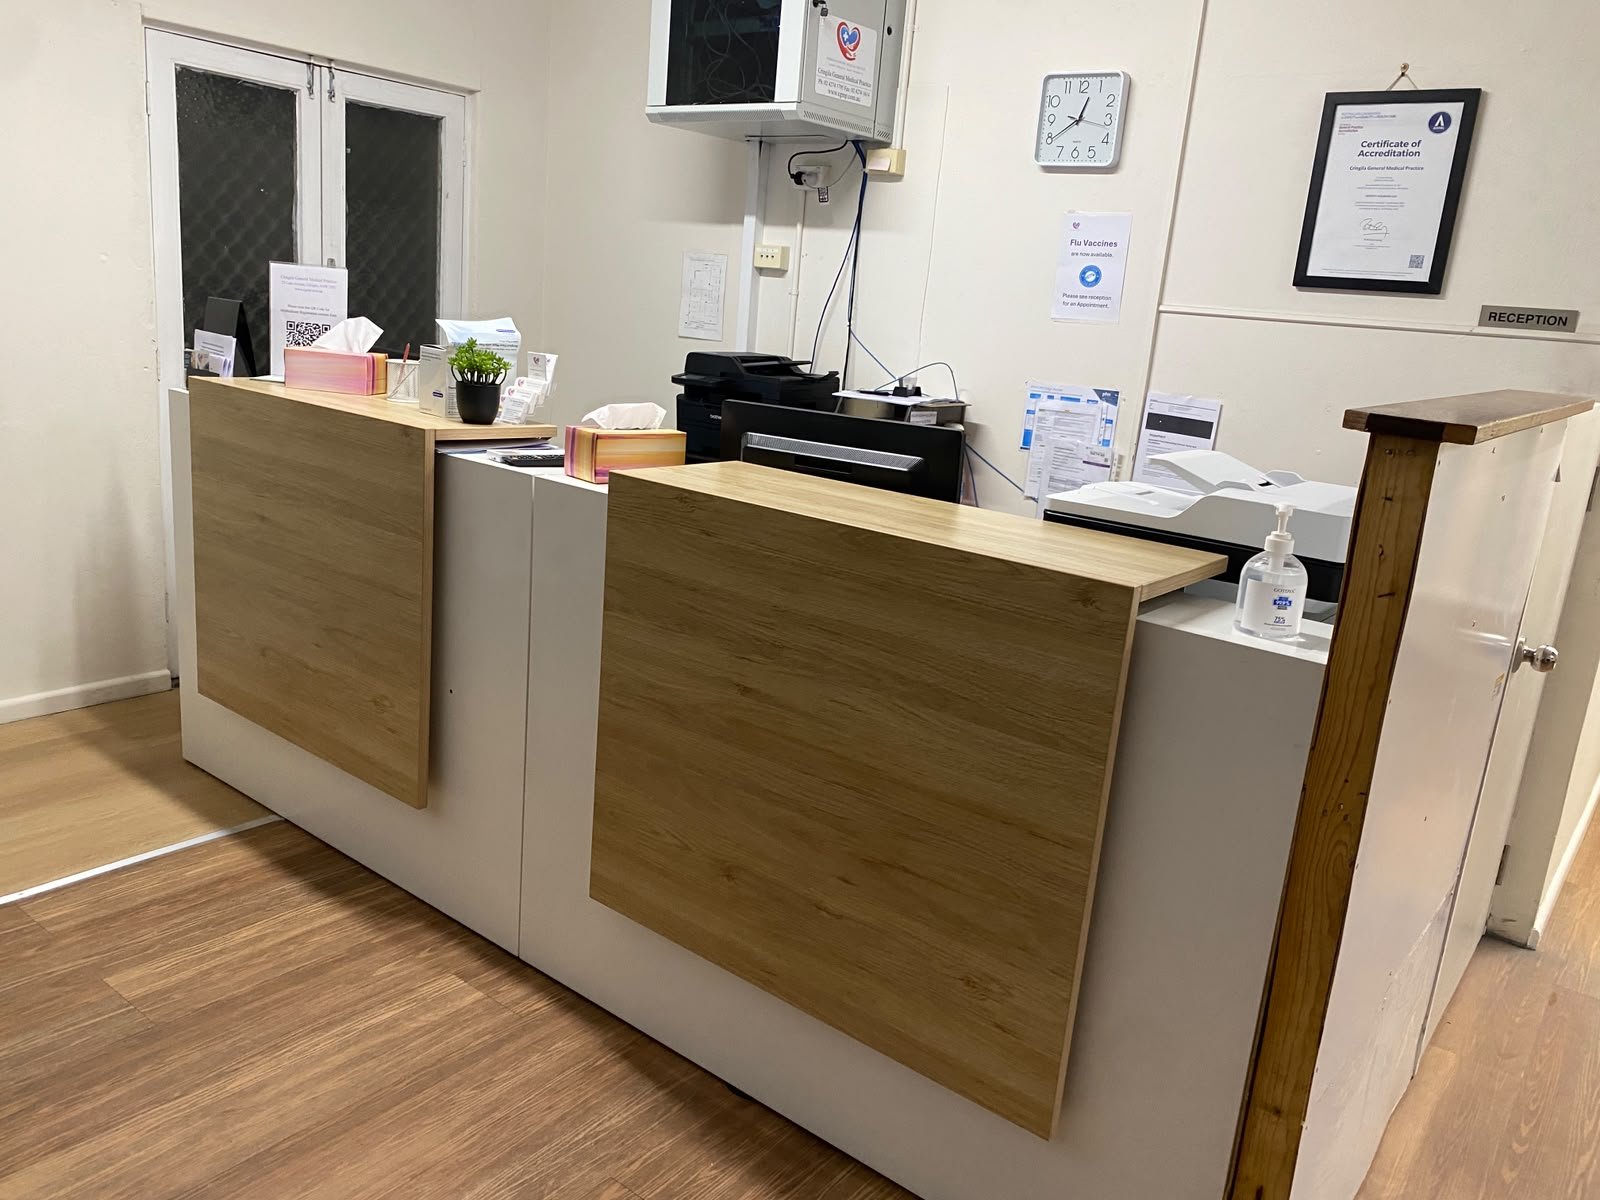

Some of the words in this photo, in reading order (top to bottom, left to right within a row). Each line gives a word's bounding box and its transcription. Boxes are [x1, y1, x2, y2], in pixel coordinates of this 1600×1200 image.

[832, 72, 845, 80] General
[846, 76, 858, 84] Medical
[1065, 81, 1072, 94] 11
[1079, 80, 1090, 94] 12
[1048, 95, 1061, 108] 10
[1106, 94, 1116, 107] 2
[1048, 114, 1056, 126] 9
[1104, 113, 1112, 126] 3
[1046, 132, 1053, 145] 8
[1102, 132, 1110, 145] 4
[1361, 140, 1409, 148] Certificate
[1411, 140, 1422, 148] of
[1056, 146, 1064, 158] 7
[1071, 146, 1080, 159] 6
[1088, 146, 1096, 159] 5
[1358, 149, 1420, 157] Accreditation
[1084, 240, 1118, 248] Vaccines
[1488, 312, 1568, 326] RECEPTION
